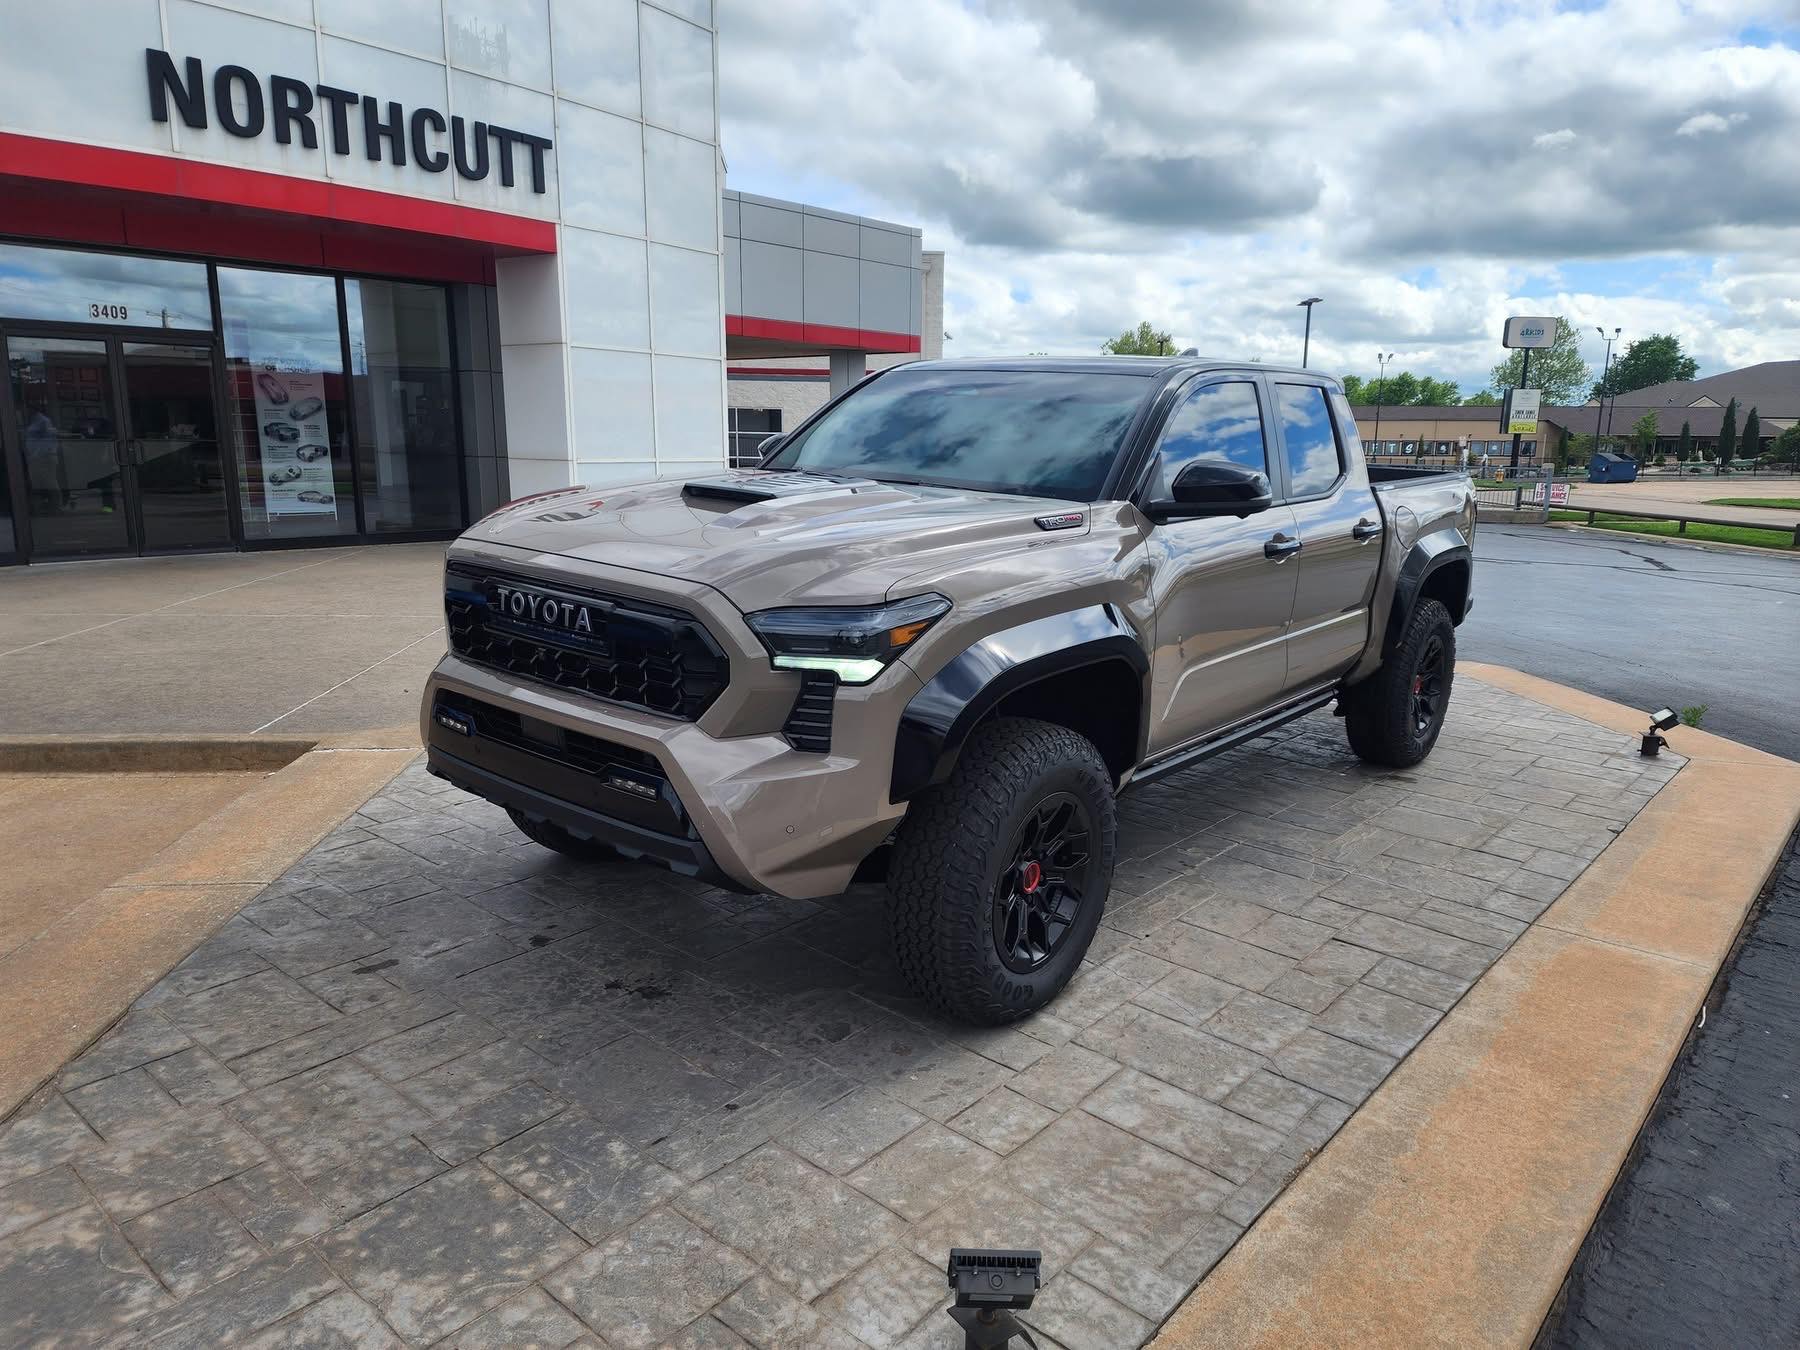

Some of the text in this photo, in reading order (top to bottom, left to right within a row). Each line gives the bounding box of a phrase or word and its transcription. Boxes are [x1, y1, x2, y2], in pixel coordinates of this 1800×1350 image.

[145, 48, 553, 194] NORTHCUTT
[91, 304, 128, 320] 3409
[1536, 491, 1567, 499] ENANCE
[1540, 483, 1565, 491] SVICE
[497, 588, 592, 633] TOYOTA
